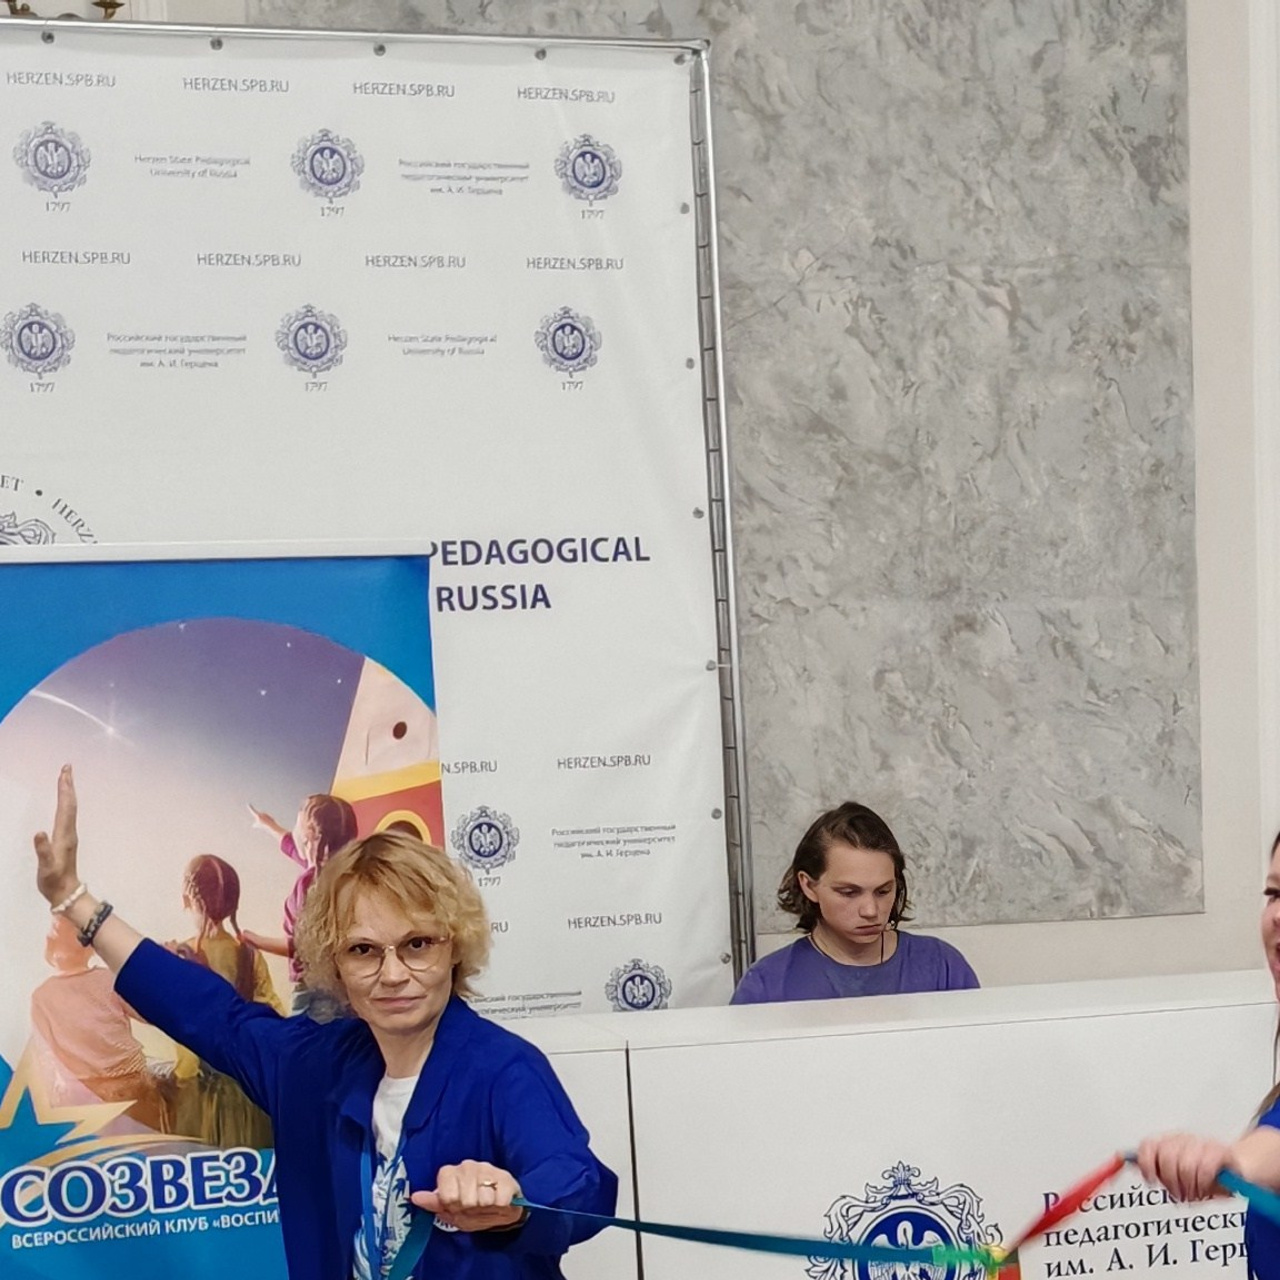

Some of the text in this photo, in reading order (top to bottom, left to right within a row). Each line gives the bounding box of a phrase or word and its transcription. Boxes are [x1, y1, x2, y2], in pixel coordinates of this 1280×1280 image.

[6, 72, 116, 88] HERZEN.SPB.RU
[183, 77, 290, 93] HERZEN.SPB.RU
[353, 82, 455, 98] HERZEN.SPB.RU
[517, 87, 615, 103] HERZEN.SPB.RU
[22, 250, 131, 265] HERZEN.SPB.RU
[196, 253, 301, 267] HERZEN.SPB.RU
[365, 255, 466, 268] HERZEN.SPB.RU
[526, 257, 624, 270] HERZEN.SPB.RU
[436, 583, 552, 612] RUSSIA
[557, 755, 651, 770] HERZEN.SPB.RU
[568, 913, 662, 929] HERZEN.SPB.RU
[12, 1219, 161, 1249] ВСЕРОССИЙСКИЙ
[165, 1216, 209, 1233] КЛУБ
[1045, 1258, 1094, 1279] им.
[1107, 1247, 1134, 1272] А.
[1147, 1243, 1178, 1268] И.
